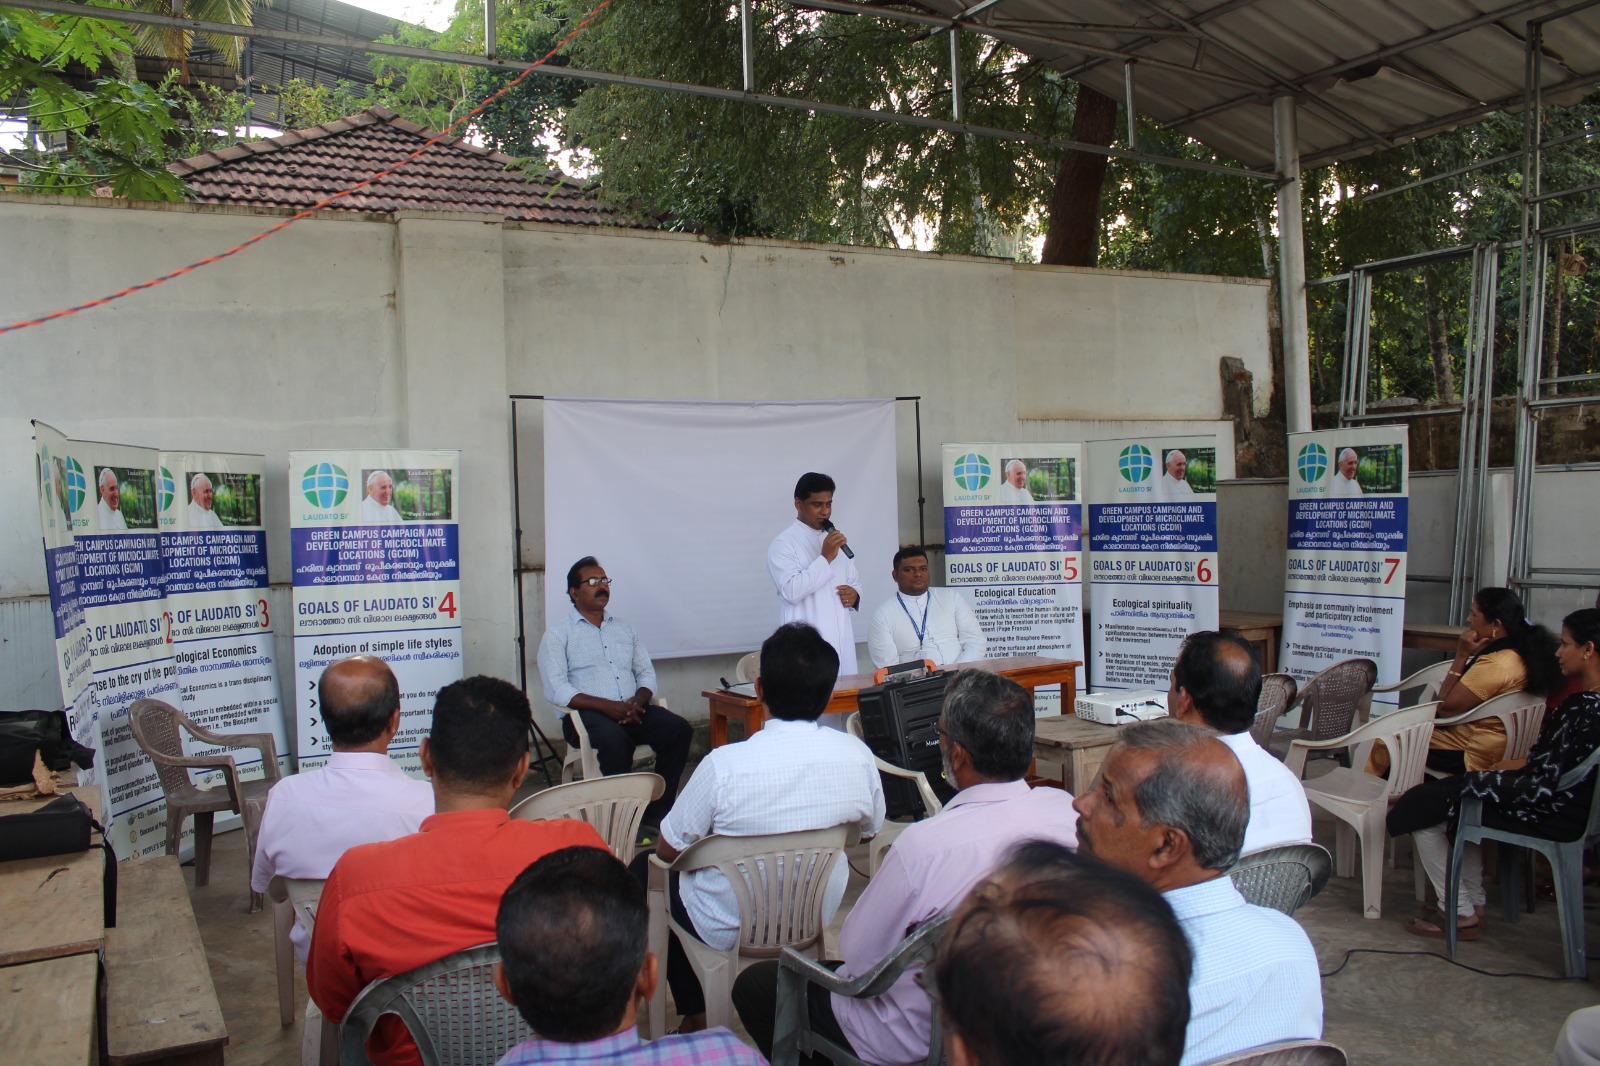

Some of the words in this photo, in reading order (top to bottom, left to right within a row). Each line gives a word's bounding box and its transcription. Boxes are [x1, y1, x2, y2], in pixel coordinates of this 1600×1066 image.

[960, 509, 984, 517] GREEN
[985, 508, 1015, 517] CAMPUS
[1016, 507, 1053, 516] CAMPAIGN
[1054, 507, 1068, 515] AND
[1102, 507, 1123, 515] GREEN
[1124, 506, 1151, 515] CAMPUS
[1152, 506, 1187, 514] CAMPAIGN
[1187, 505, 1203, 514] AND
[1299, 502, 1318, 511] GREEN
[1319, 502, 1345, 510] CAMPUS
[1345, 501, 1379, 510] CAMPAIGN
[1379, 501, 1394, 510] AND
[303, 513, 339, 521] LAUDATO
[956, 518, 1008, 526] DEVELOPMENT
[1008, 517, 1018, 525] OF
[1019, 515, 1071, 525] MICROCLIMATE
[1098, 515, 1144, 523] DEVELOPMENT
[1145, 515, 1154, 523] OF
[1155, 514, 1205, 523] MICROCLIMATE
[1295, 511, 1337, 520] DEVELOPMENT
[1338, 511, 1346, 519] OF
[1347, 510, 1396, 519] MICROCLIMATE
[982, 525, 1020, 534] LOCATIONS
[1021, 525, 1048, 534] (GCDM)
[1121, 523, 1156, 532] LOCATIONS
[1158, 523, 1182, 533] (GCDM)
[1315, 520, 1348, 529] LOCATIONS
[1349, 520, 1372, 530] (GCDM)
[171, 535, 204, 546] CAMPUS
[205, 534, 243, 545] CAMPAIGN
[243, 534, 256, 544] AND
[311, 530, 340, 541] GREEN
[342, 529, 379, 540] CAMPUS
[381, 528, 425, 539] CAMPAIGN
[427, 528, 444, 537] AND
[85, 539, 113, 551] CAMPUS
[114, 538, 146, 550] CAMPAIGN
[197, 546, 208, 556] OF
[209, 544, 259, 555] MICROCLIMATE
[306, 540, 368, 551] DEVELOPMENT
[371, 539, 382, 549] OF
[384, 538, 447, 549] MICROCLIMATE
[108, 550, 117, 563] OF
[117, 549, 159, 562] MICROCLIMATE
[338, 549, 385, 561] LOCATIONS
[388, 549, 419, 560] (GCDM)
[169, 556, 211, 568] LOCATIONS
[213, 555, 241, 567] (GCDM)
[84, 563, 120, 577] LOCATIONS
[950, 563, 983, 574] GOALS
[986, 562, 999, 573] OF
[1001, 561, 1047, 572] LAUDATO
[1063, 556, 1078, 581] 5
[1093, 560, 1122, 571] GOALS
[1124, 560, 1136, 571] OF
[1138, 561, 1182, 572] LAUDATO
[1197, 558, 1212, 583] 6
[1288, 559, 1314, 570] GOALS
[1316, 559, 1327, 571] OF
[1329, 560, 1370, 573] LAUDATO
[1383, 558, 1401, 585] 7
[974, 588, 1015, 599] Ecological
[1017, 587, 1056, 596] Education
[298, 600, 339, 615] GOALS
[343, 599, 360, 613] OF
[363, 597, 418, 612] LAUDATO
[438, 591, 457, 619] 4
[1112, 598, 1150, 610] Ecological
[1151, 600, 1193, 612] spirituality
[1288, 600, 1314, 610] Emphasis
[1315, 603, 1322, 611] on
[1323, 603, 1356, 614] community
[1356, 605, 1393, 615] involvement
[177, 610, 192, 624] OF
[195, 605, 241, 622] LAUDATO
[258, 599, 270, 628] 3
[1304, 611, 1315, 619] and
[1315, 611, 1353, 623] participatory
[1353, 614, 1373, 623] action
[95, 625, 107, 642] OF
[109, 620, 148, 639] LAUDATO
[163, 611, 173, 644] 2
[313, 644, 357, 657] Adoption
[359, 642, 369, 653] of
[372, 640, 405, 652] simple
[407, 639, 423, 650] life
[425, 638, 453, 650] styles
[1292, 642, 1301, 650] The
[1301, 643, 1313, 651] active
[1314, 645, 1341, 655] participation
[176, 648, 210, 664] ological
[212, 644, 257, 659] Economics
[1292, 649, 1315, 659] community
[108, 677, 116, 689] to
[117, 674, 129, 686] the
[130, 672, 142, 685] cry
[144, 670, 151, 680] of
[189, 682, 217, 693] Economics
[228, 679, 242, 687] trans
[242, 675, 272, 684] disciplinary
[181, 693, 196, 702] study
[189, 708, 209, 718] system
[399, 709, 426, 718] mportant
[232, 716, 258, 727] Biosphere
[194, 747, 220, 757] extraction
